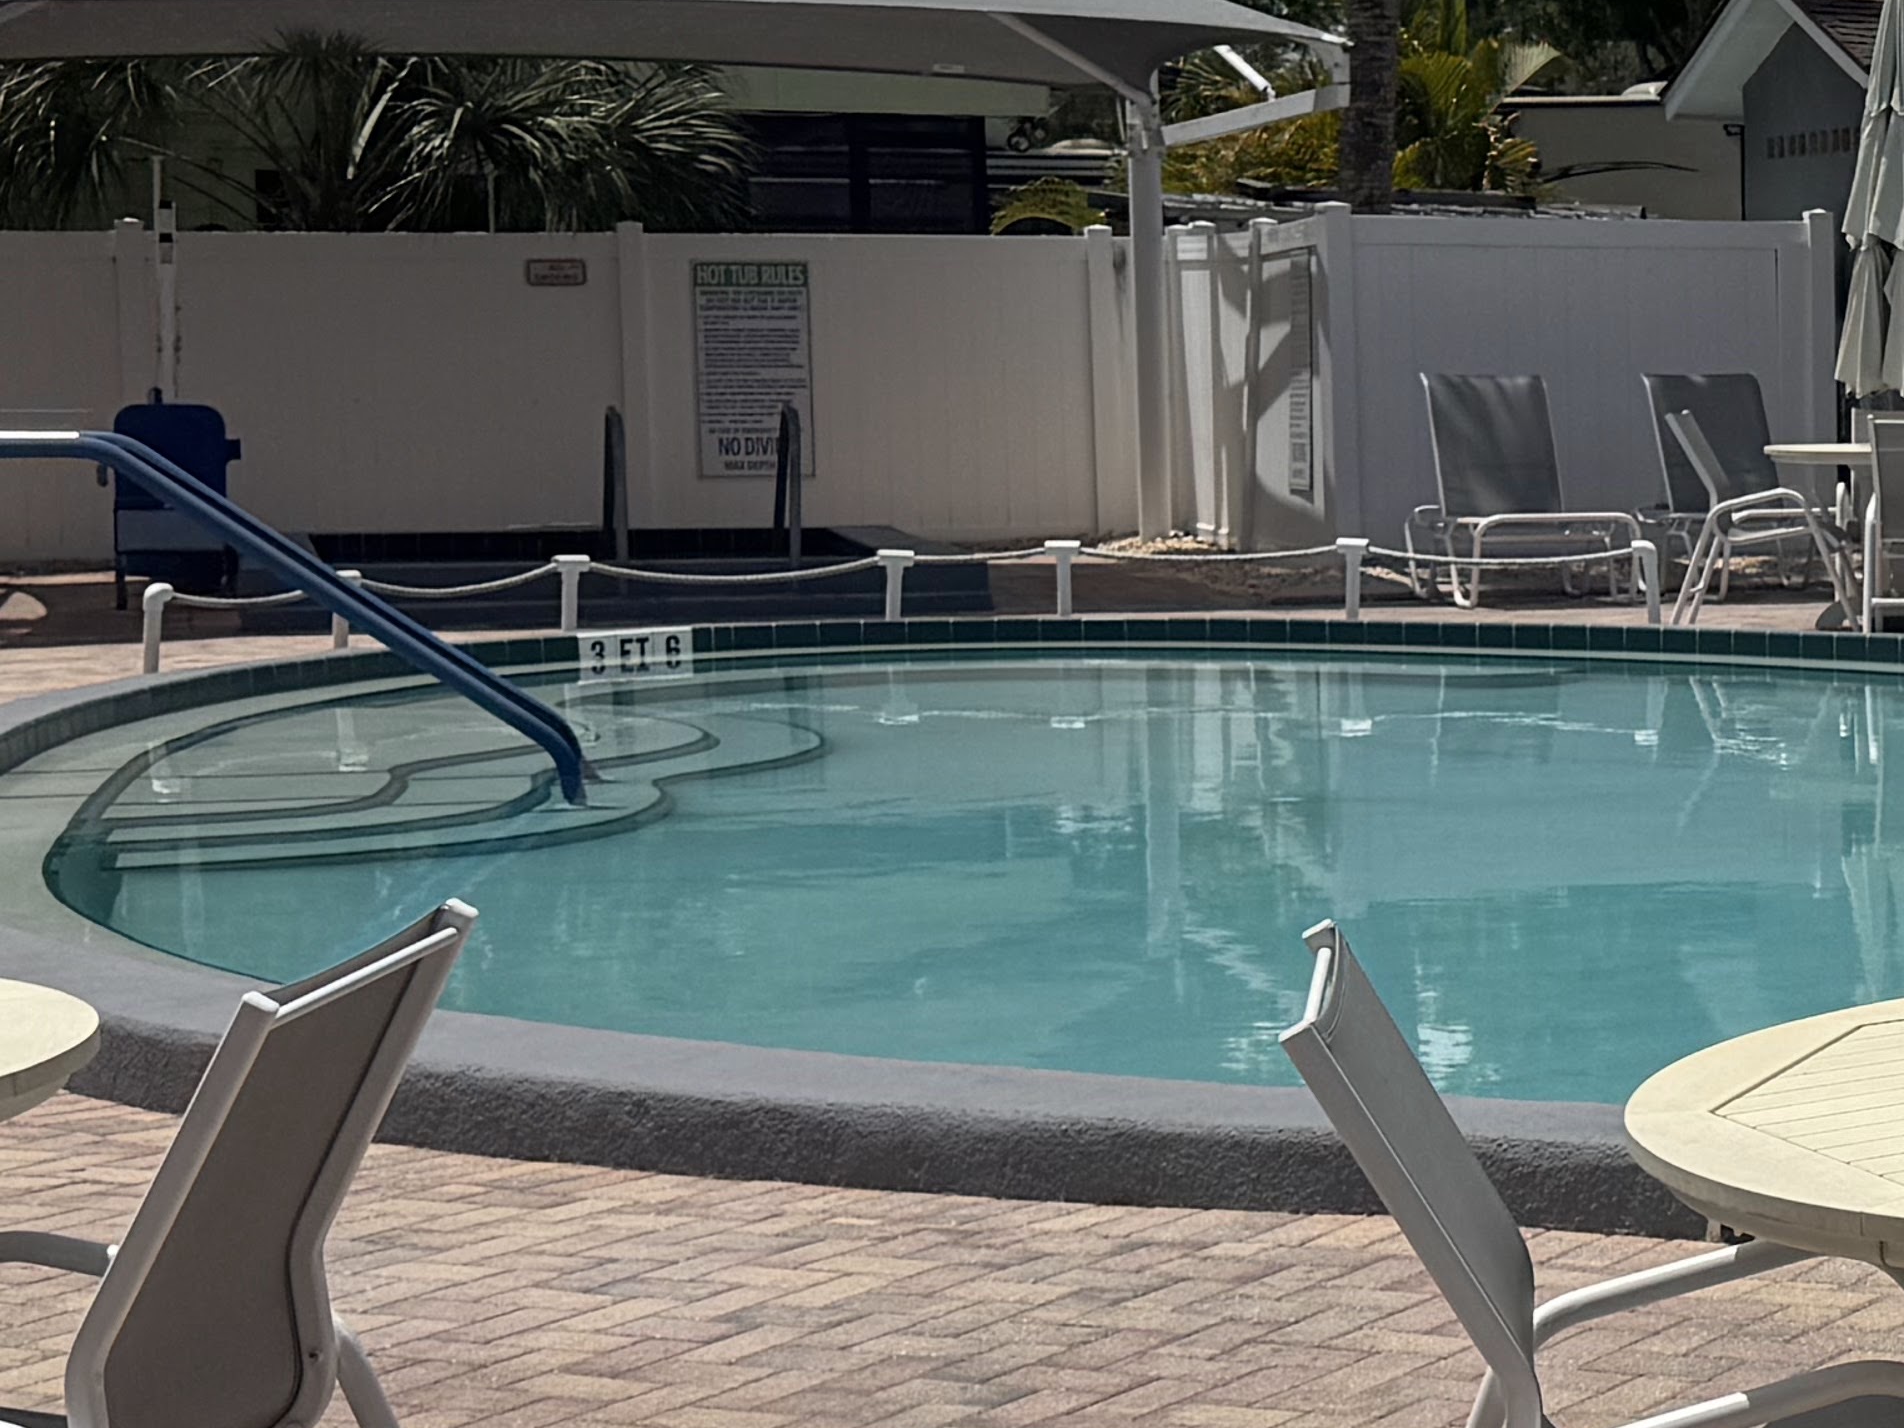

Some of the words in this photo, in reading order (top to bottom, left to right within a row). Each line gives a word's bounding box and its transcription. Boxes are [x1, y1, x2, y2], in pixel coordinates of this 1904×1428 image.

[697, 264, 726, 285] HOT
[732, 264, 759, 285] TUB
[761, 264, 804, 285] RULES
[718, 437, 741, 456] NO
[744, 437, 782, 456] DIVI
[591, 640, 606, 662] 3
[620, 637, 649, 661] FT
[666, 635, 681, 659] 6
